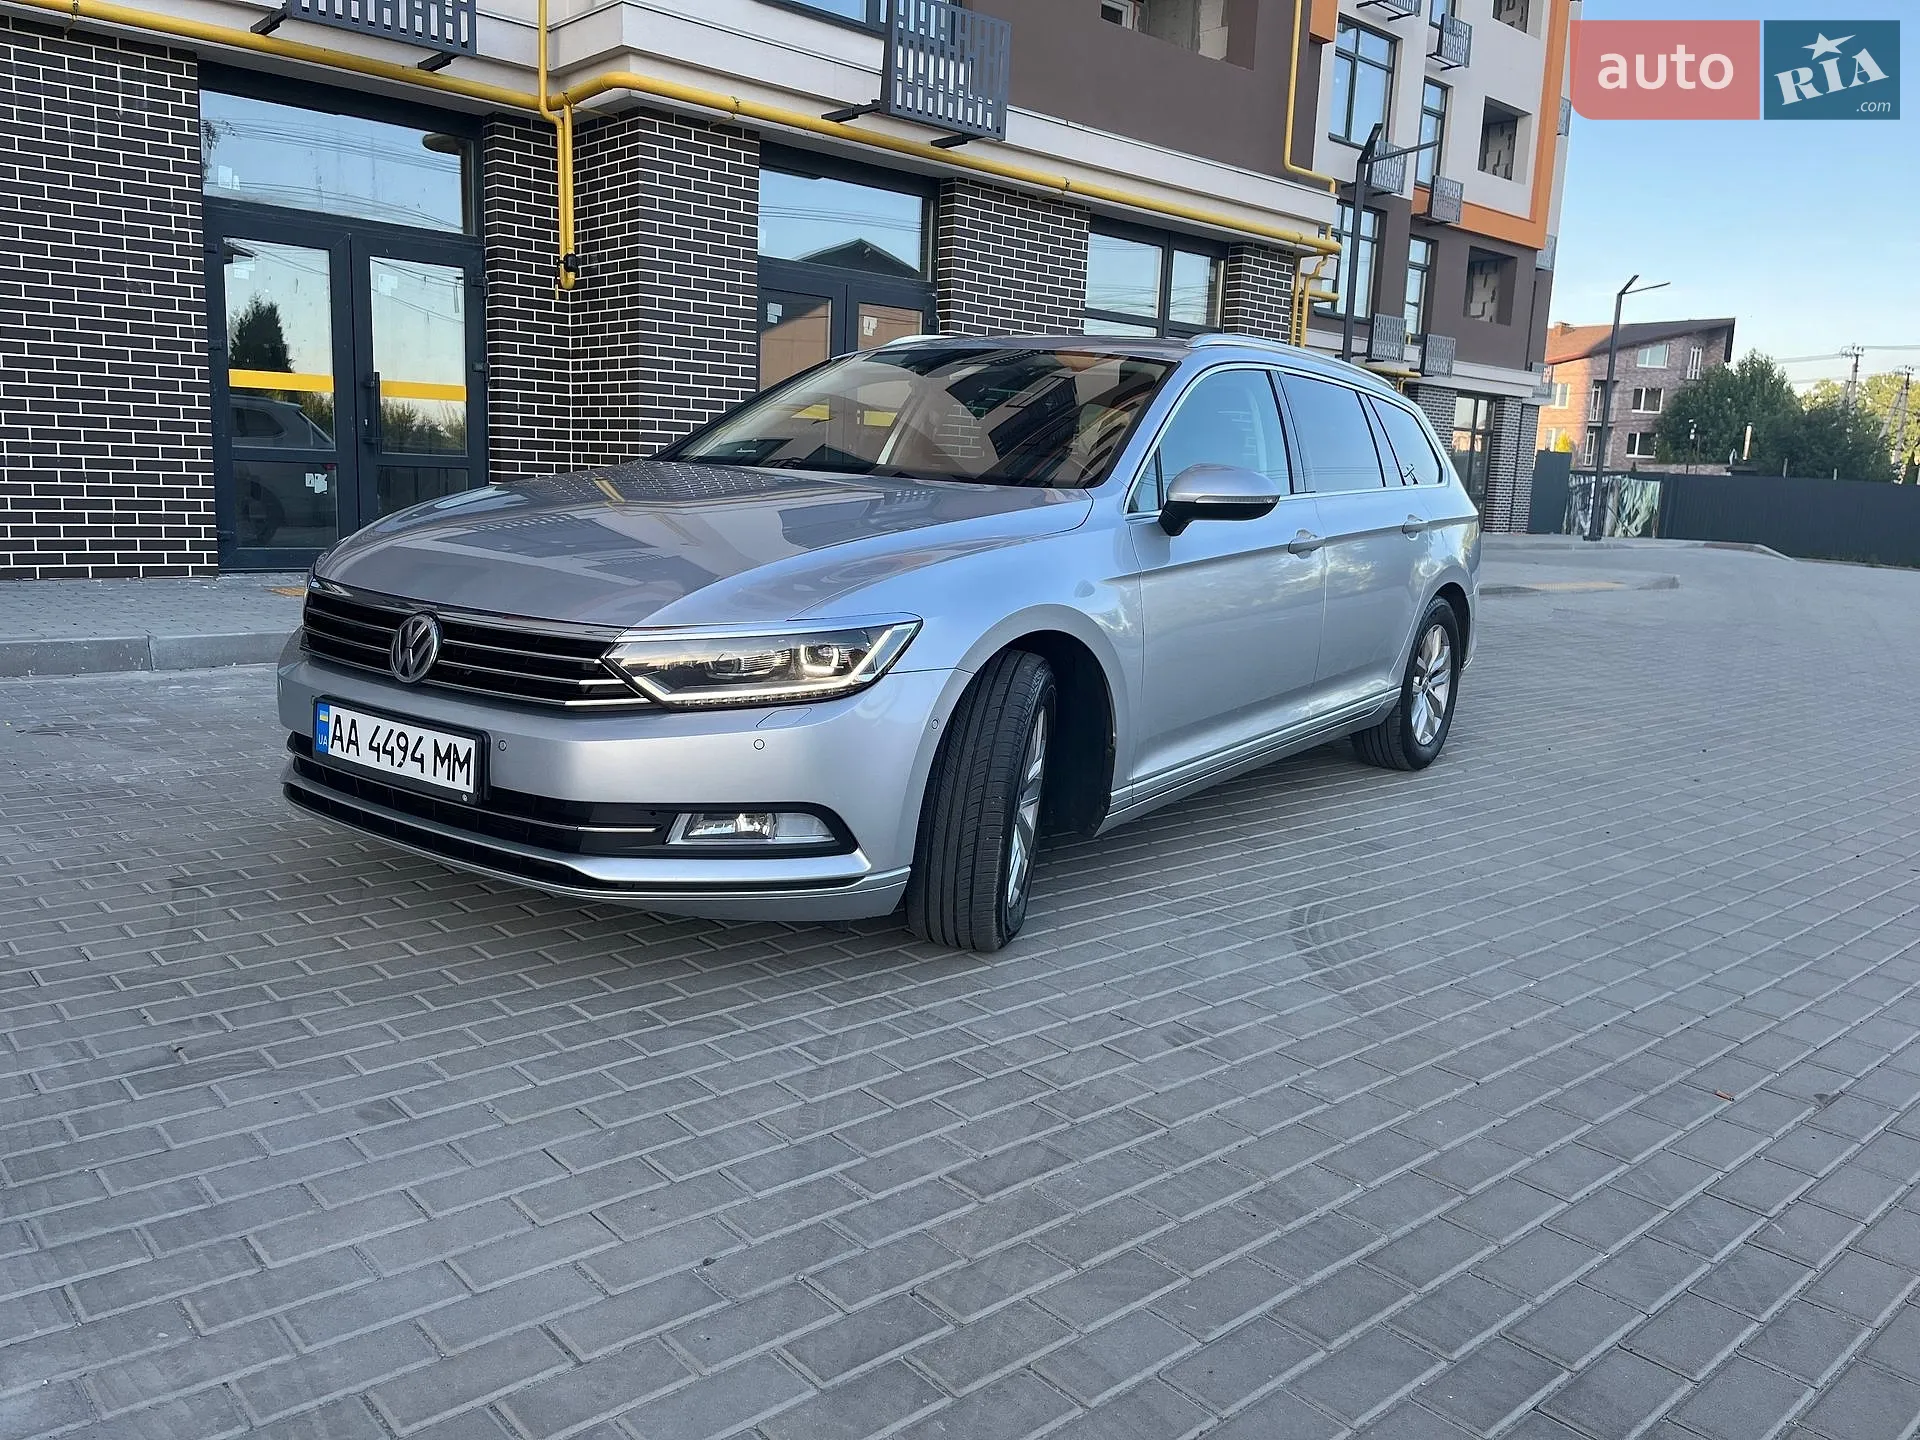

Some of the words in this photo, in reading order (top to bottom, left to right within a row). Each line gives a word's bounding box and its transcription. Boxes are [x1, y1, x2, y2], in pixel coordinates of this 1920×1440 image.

[318, 734, 328, 747] UA
[330, 714, 360, 757] AA
[368, 725, 425, 774] 4494
[433, 738, 472, 785] MM
